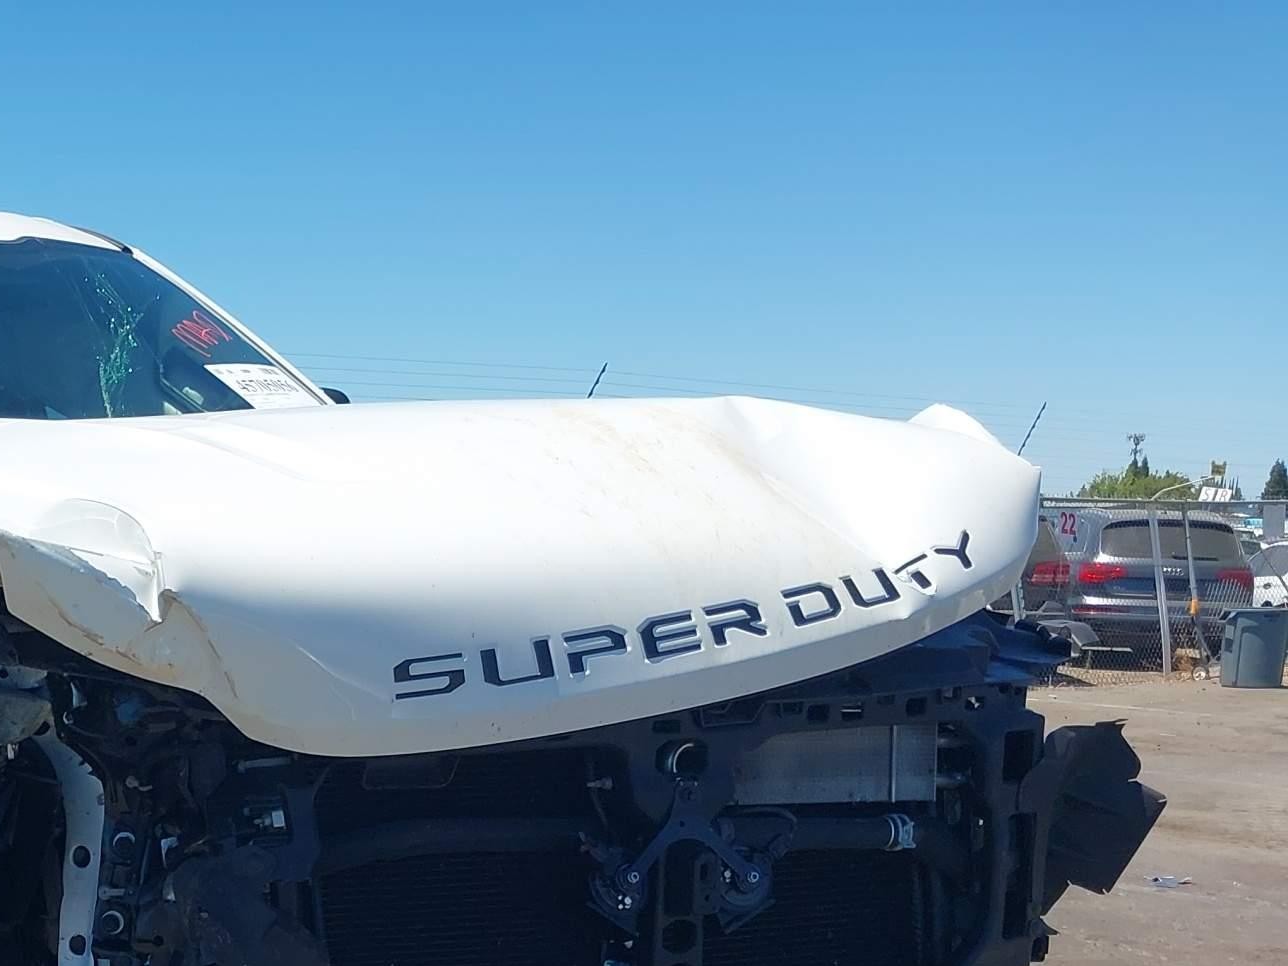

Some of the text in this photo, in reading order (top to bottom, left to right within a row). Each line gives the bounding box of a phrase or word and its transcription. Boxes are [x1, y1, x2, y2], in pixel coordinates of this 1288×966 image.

[1060, 511, 1077, 536] 22
[393, 528, 976, 701] SUPER DUTY
